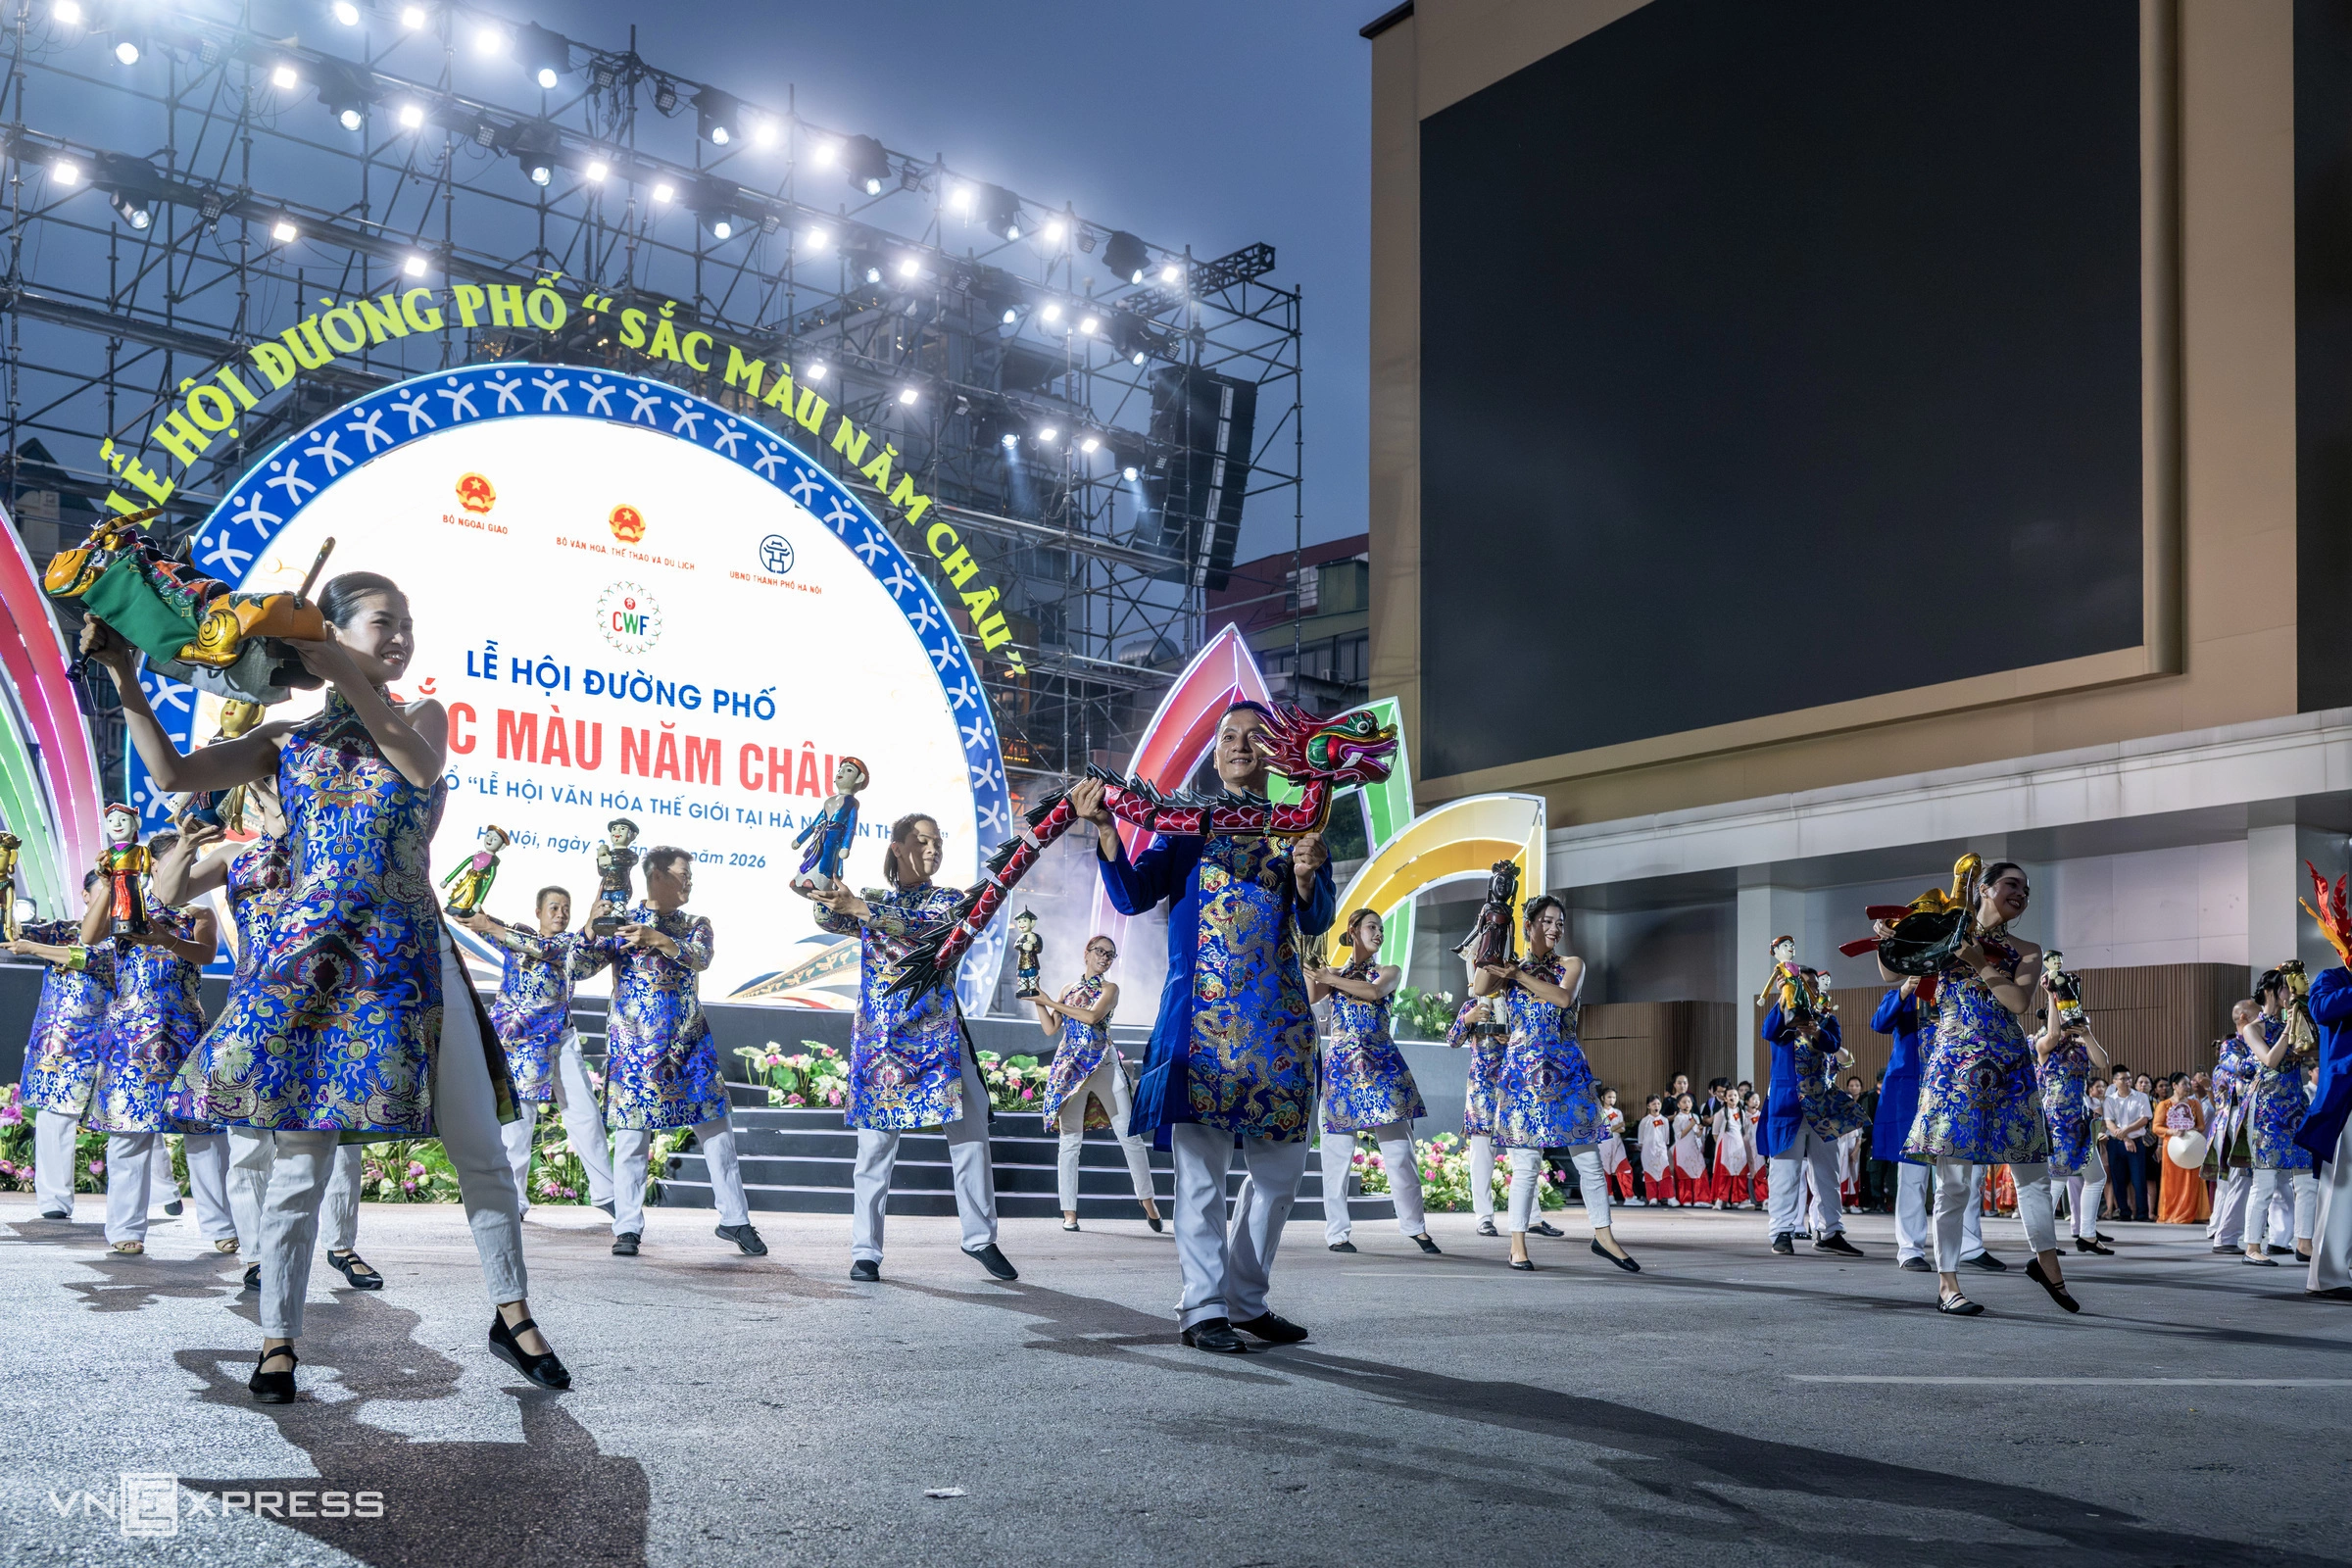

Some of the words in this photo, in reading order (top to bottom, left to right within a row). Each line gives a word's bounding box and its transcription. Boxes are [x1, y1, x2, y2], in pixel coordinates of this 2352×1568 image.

[151, 366, 259, 467] HỘI
[250, 289, 444, 389] ĐƯỜNG
[453, 272, 566, 330] PHỐ
[724, 346, 828, 435] MÀU
[831, 416, 933, 526] NĂM
[487, 523, 509, 535] GIAO
[729, 570, 751, 582] UBND
[612, 612, 650, 635] CWF
[467, 639, 499, 681] LỄ
[513, 654, 570, 697] HỘI
[583, 668, 703, 710] ĐƯỜNG
[713, 686, 777, 721] PHỐ
[496, 705, 603, 771] MÀU
[620, 720, 722, 787] NĂM
[507, 779, 543, 805] HỘI
[552, 784, 593, 807] VĂN
[601, 790, 644, 812] HÓA
[651, 795, 685, 817] THẾ
[689, 799, 729, 822] GIỚI
[736, 808, 762, 830] TẠI
[770, 808, 795, 829] HÀ
[547, 835, 591, 854] ngày
[728, 852, 766, 869] 2026
